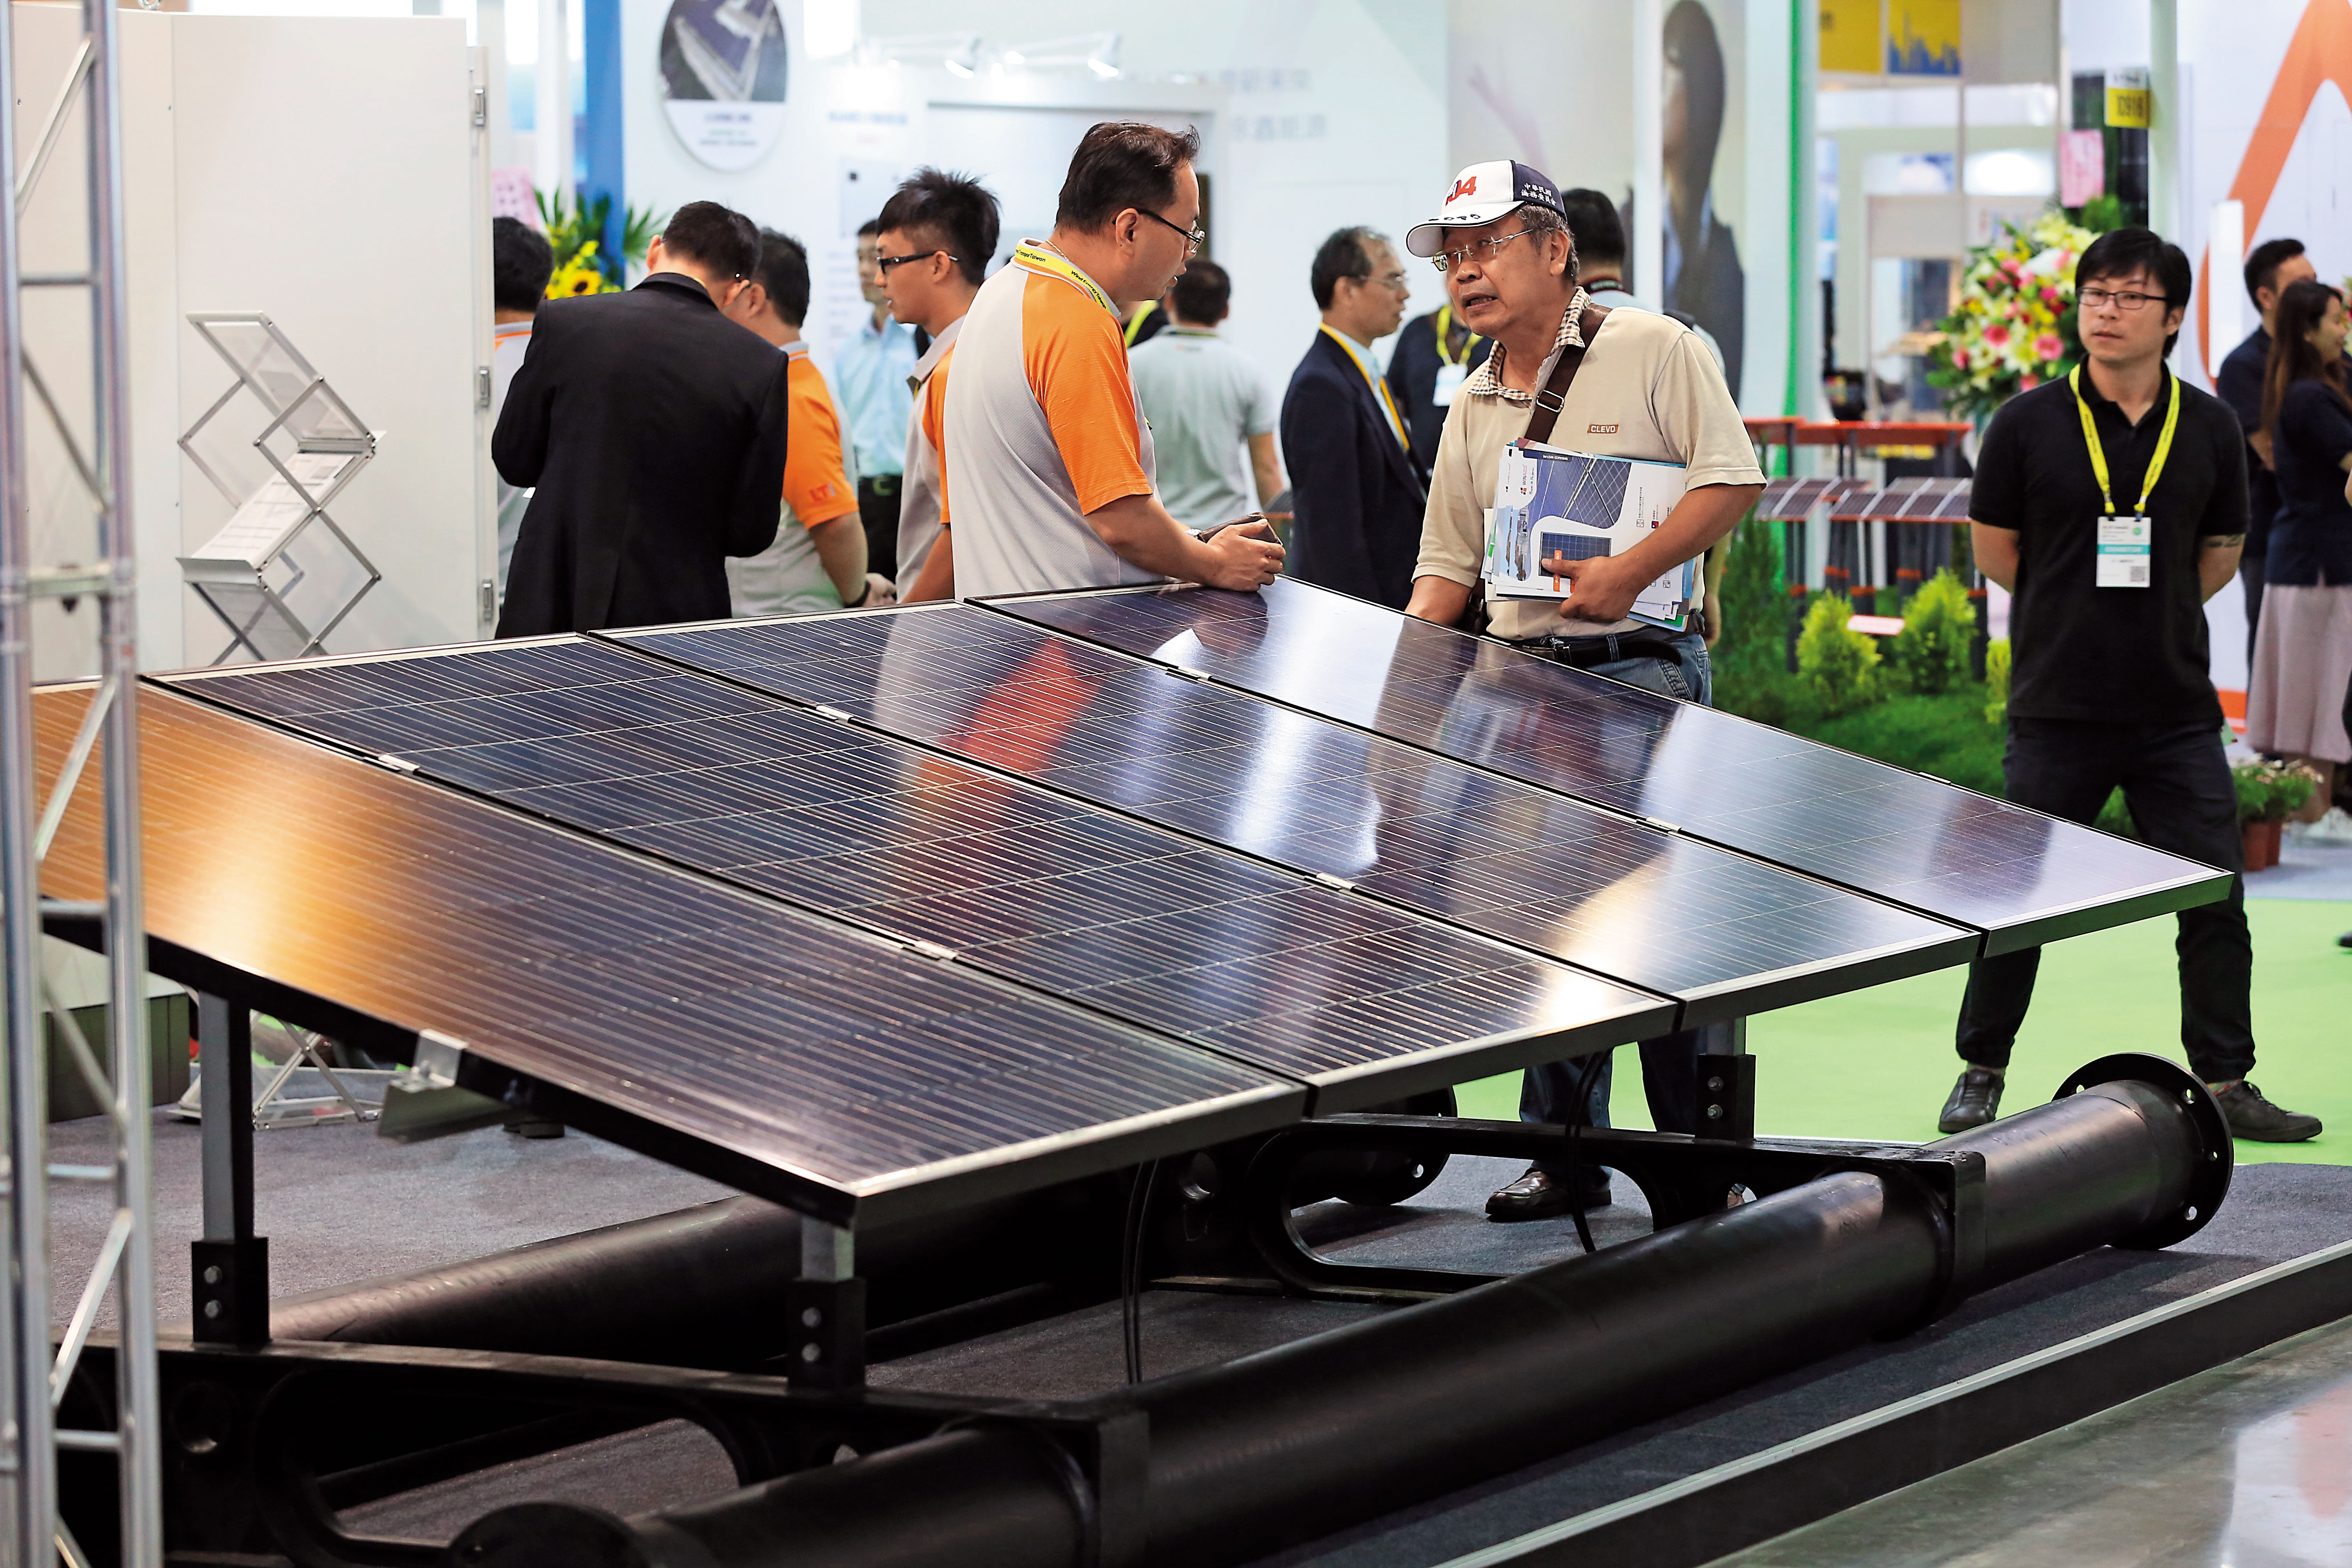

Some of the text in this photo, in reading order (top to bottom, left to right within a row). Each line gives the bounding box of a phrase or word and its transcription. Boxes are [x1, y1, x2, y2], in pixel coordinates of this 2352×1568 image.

[1524, 183, 1552, 197] 中華民國
[1520, 189, 1556, 206] 僑務委員會
[1071, 270, 1084, 281] Wind
[1591, 425, 1616, 433] CLEVO
